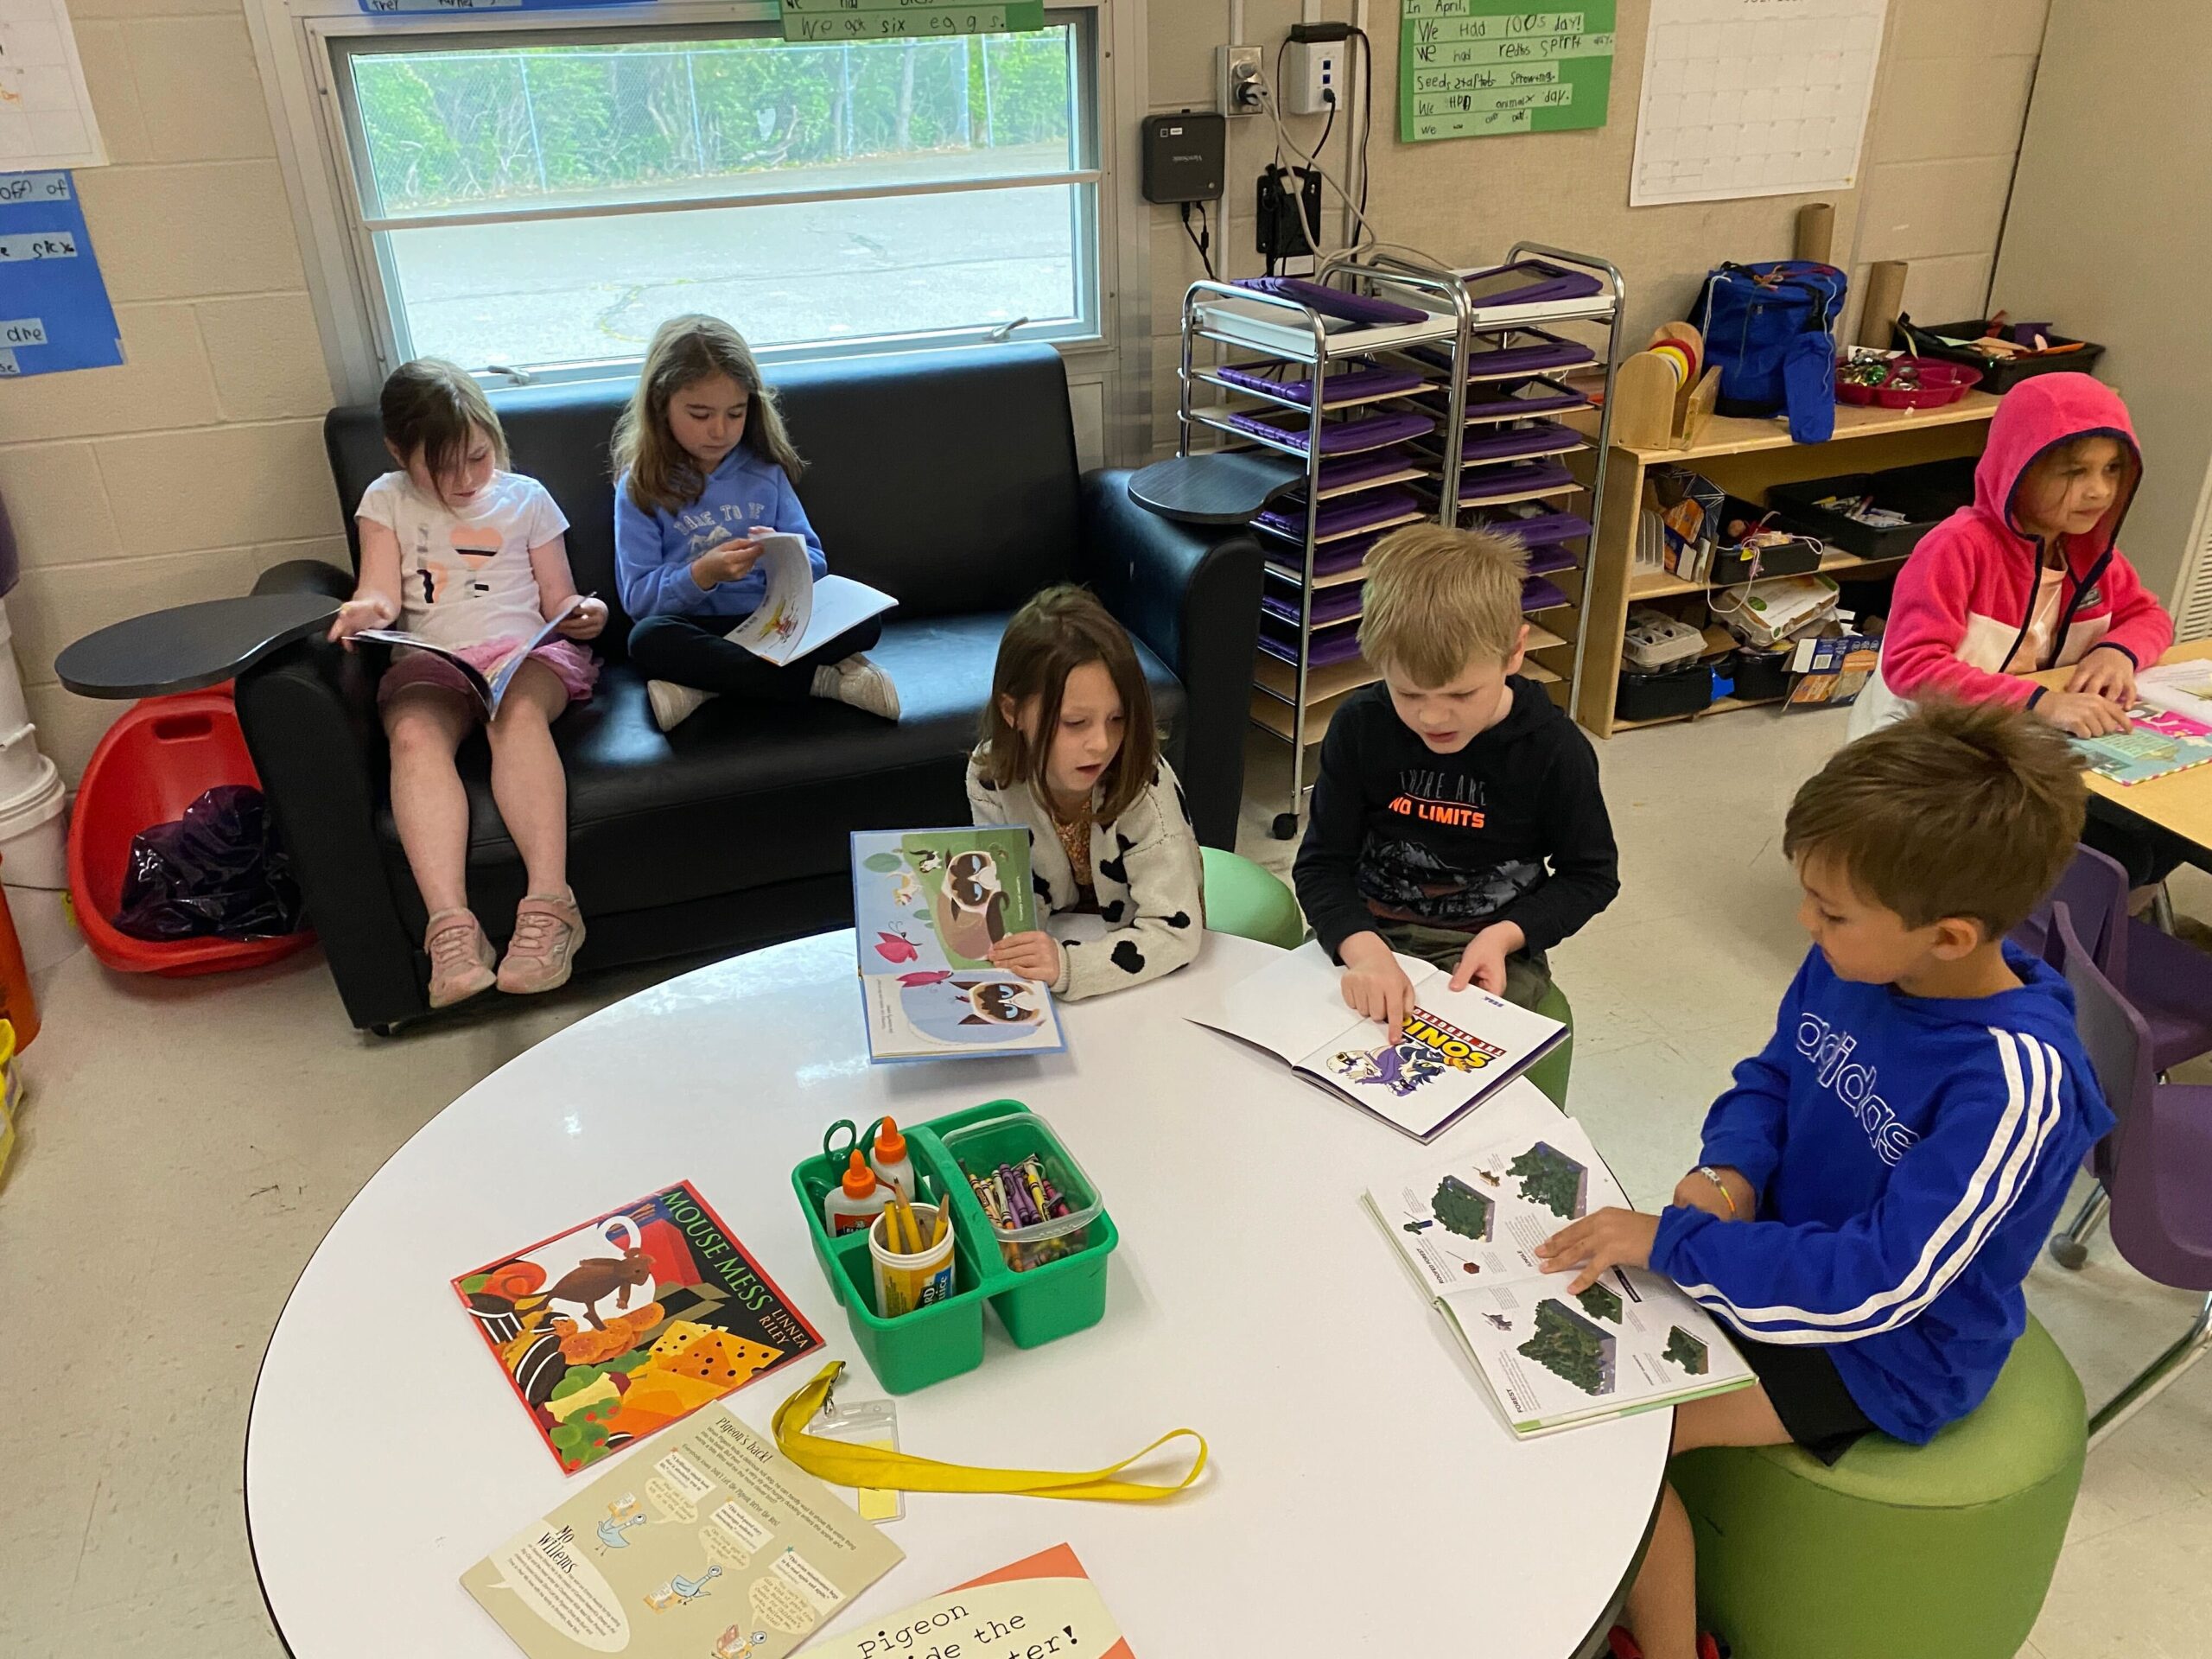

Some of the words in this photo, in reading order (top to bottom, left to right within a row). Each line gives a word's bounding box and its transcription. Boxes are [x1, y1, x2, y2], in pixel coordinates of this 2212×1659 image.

[881, 18, 906, 33] six
[1418, 18, 1439, 41] We
[720, 504, 742, 522] TO
[1399, 769, 1446, 799] THERE
[1455, 774, 1486, 806] ARE
[1389, 797, 1413, 816] NO
[1418, 804, 1485, 829] LIMITS
[1412, 1007, 1476, 1043] HEDGEHO
[1474, 1037, 1506, 1057] THE
[1796, 1013, 1920, 1166] adidas
[659, 1191, 730, 1259] MOUSE
[714, 1256, 774, 1311] MESS
[759, 1315, 791, 1344] RILEY
[772, 1308, 810, 1348] LINNEA
[1503, 1387, 1525, 1414] FOREST
[556, 1524, 575, 1544] Mo
[537, 1531, 579, 1575] Willems
[857, 1605, 969, 1659] Pigeon
[974, 1614, 1027, 1644] the
